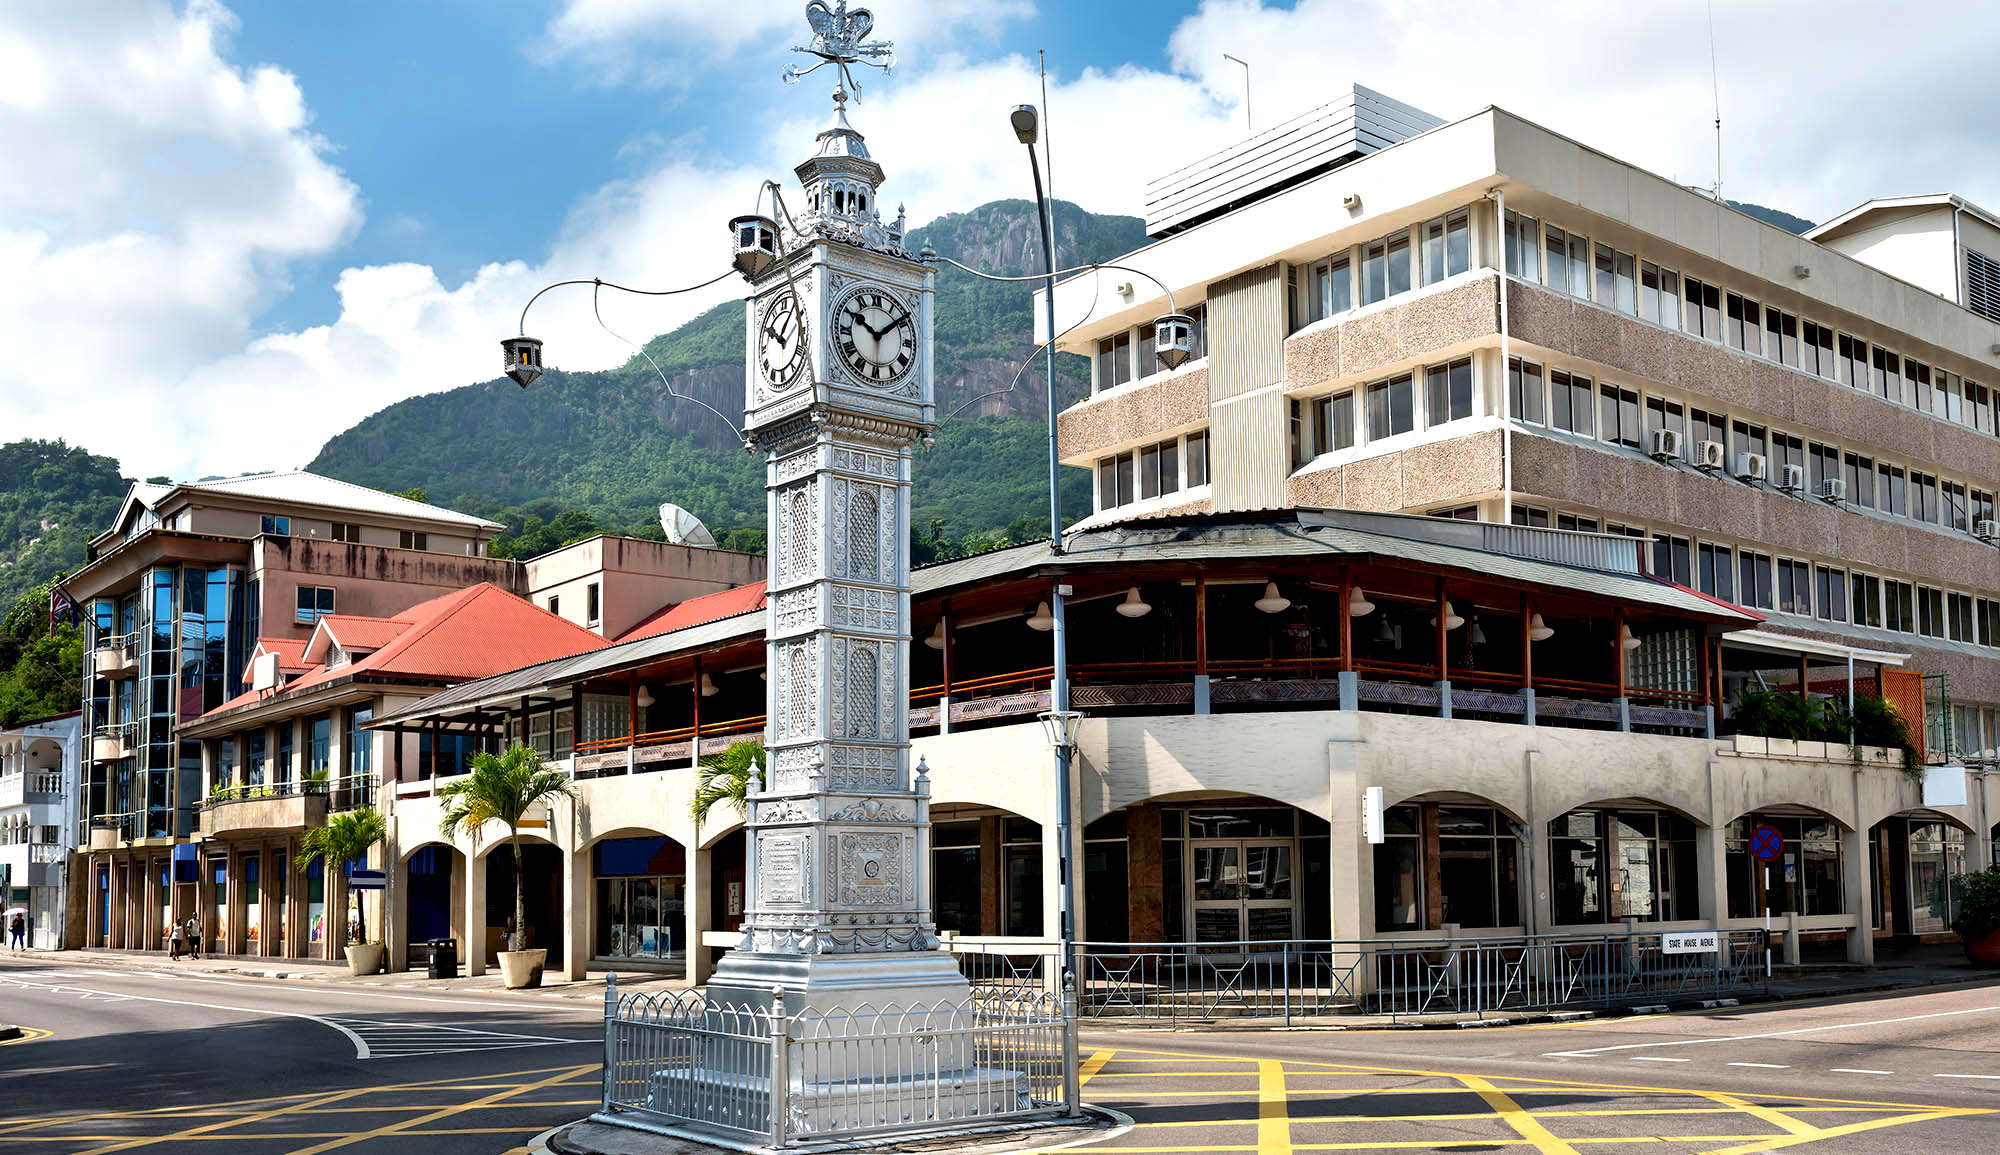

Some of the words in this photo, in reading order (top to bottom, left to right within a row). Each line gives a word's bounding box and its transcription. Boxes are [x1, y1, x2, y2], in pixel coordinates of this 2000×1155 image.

[1669, 939, 1681, 948] STATE
[1684, 938, 1697, 947] HOUSE
[1700, 938, 1714, 947] AVENUE
